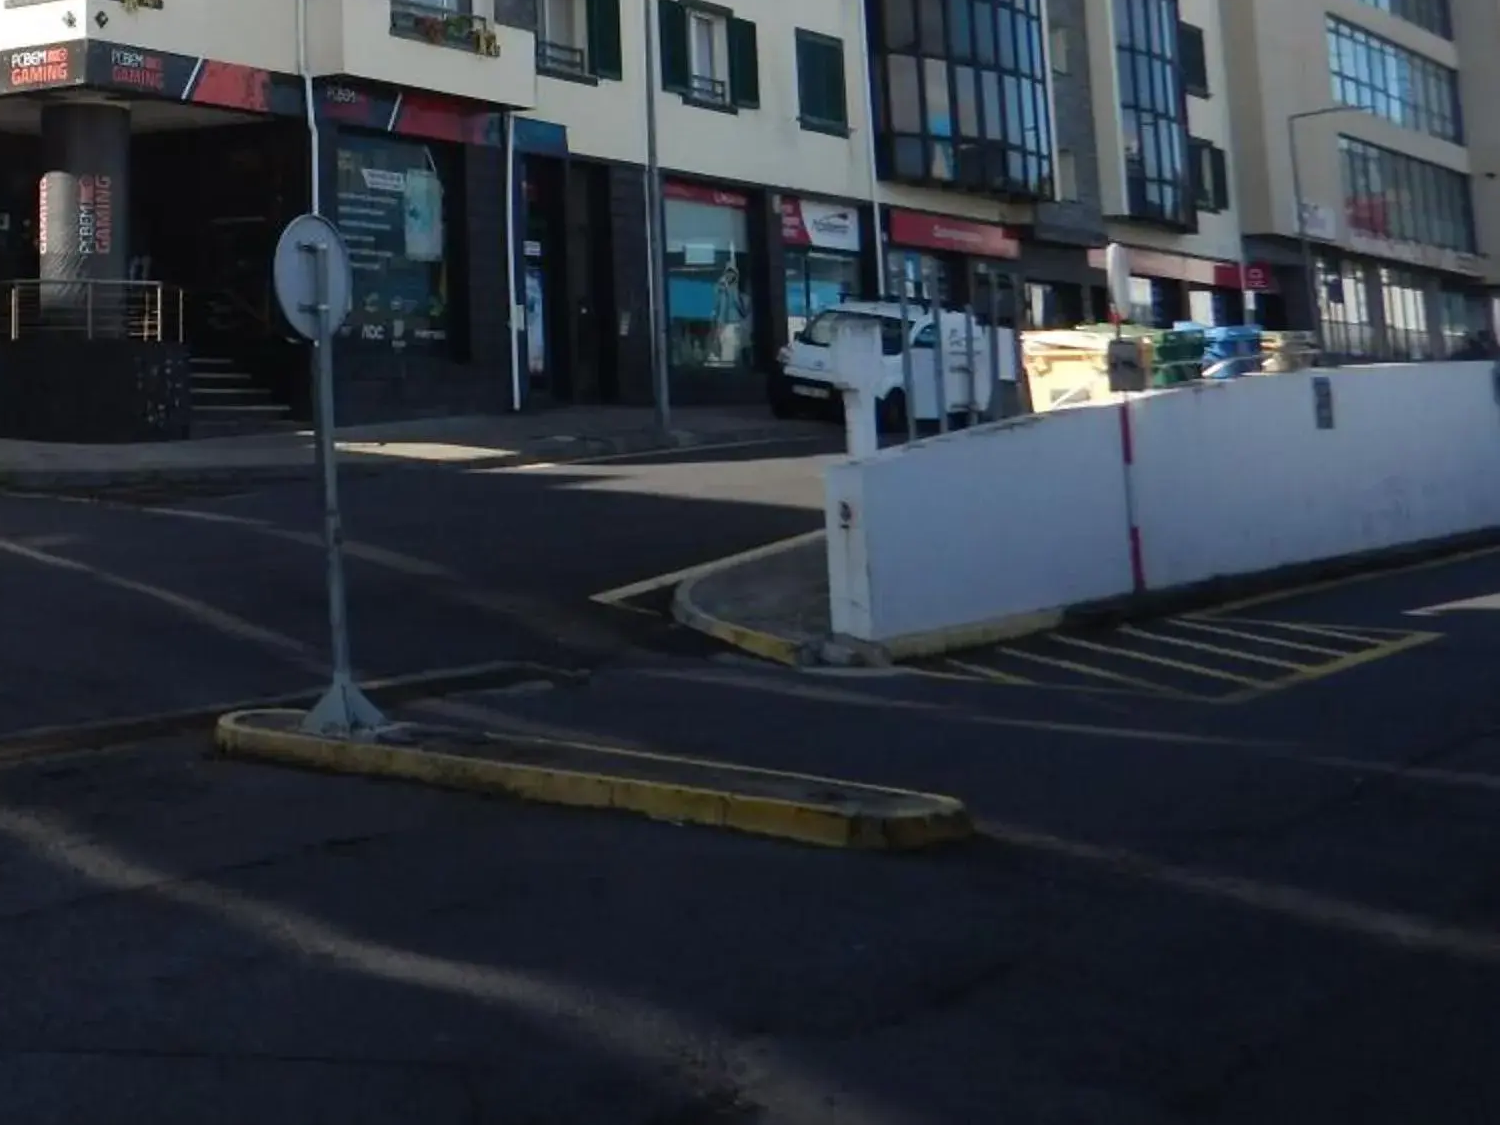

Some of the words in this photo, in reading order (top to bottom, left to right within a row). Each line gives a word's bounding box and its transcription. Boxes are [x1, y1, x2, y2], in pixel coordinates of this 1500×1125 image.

[11, 62, 68, 85] GAMING
[112, 65, 164, 89] GAMING
[96, 175, 111, 254] GAMING
